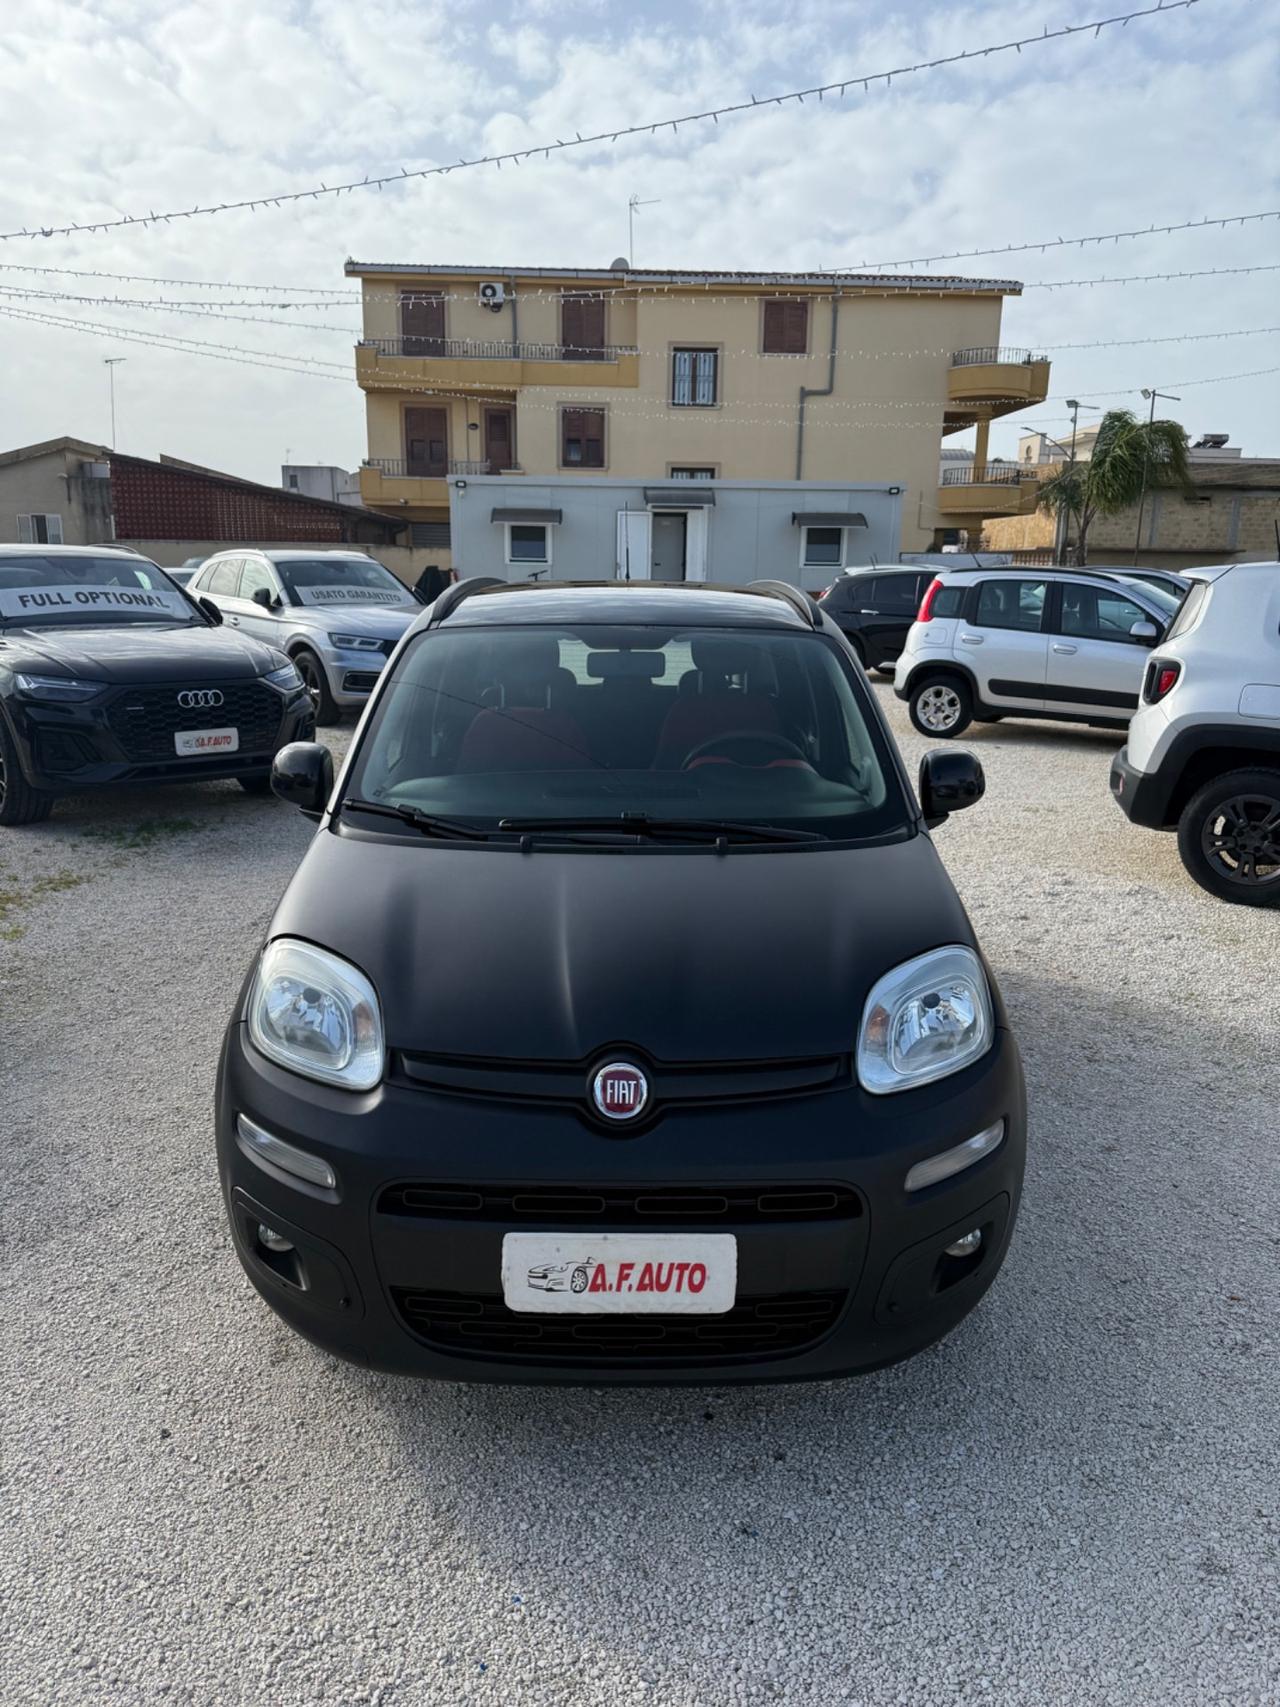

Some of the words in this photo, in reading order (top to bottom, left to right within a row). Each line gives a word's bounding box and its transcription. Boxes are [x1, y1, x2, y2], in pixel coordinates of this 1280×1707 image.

[18, 592, 72, 608] FULL
[74, 591, 171, 609] OPTIONAL
[311, 590, 345, 600] USATO
[347, 590, 401, 601] GARANTITO
[606, 1079, 637, 1105] FIAT
